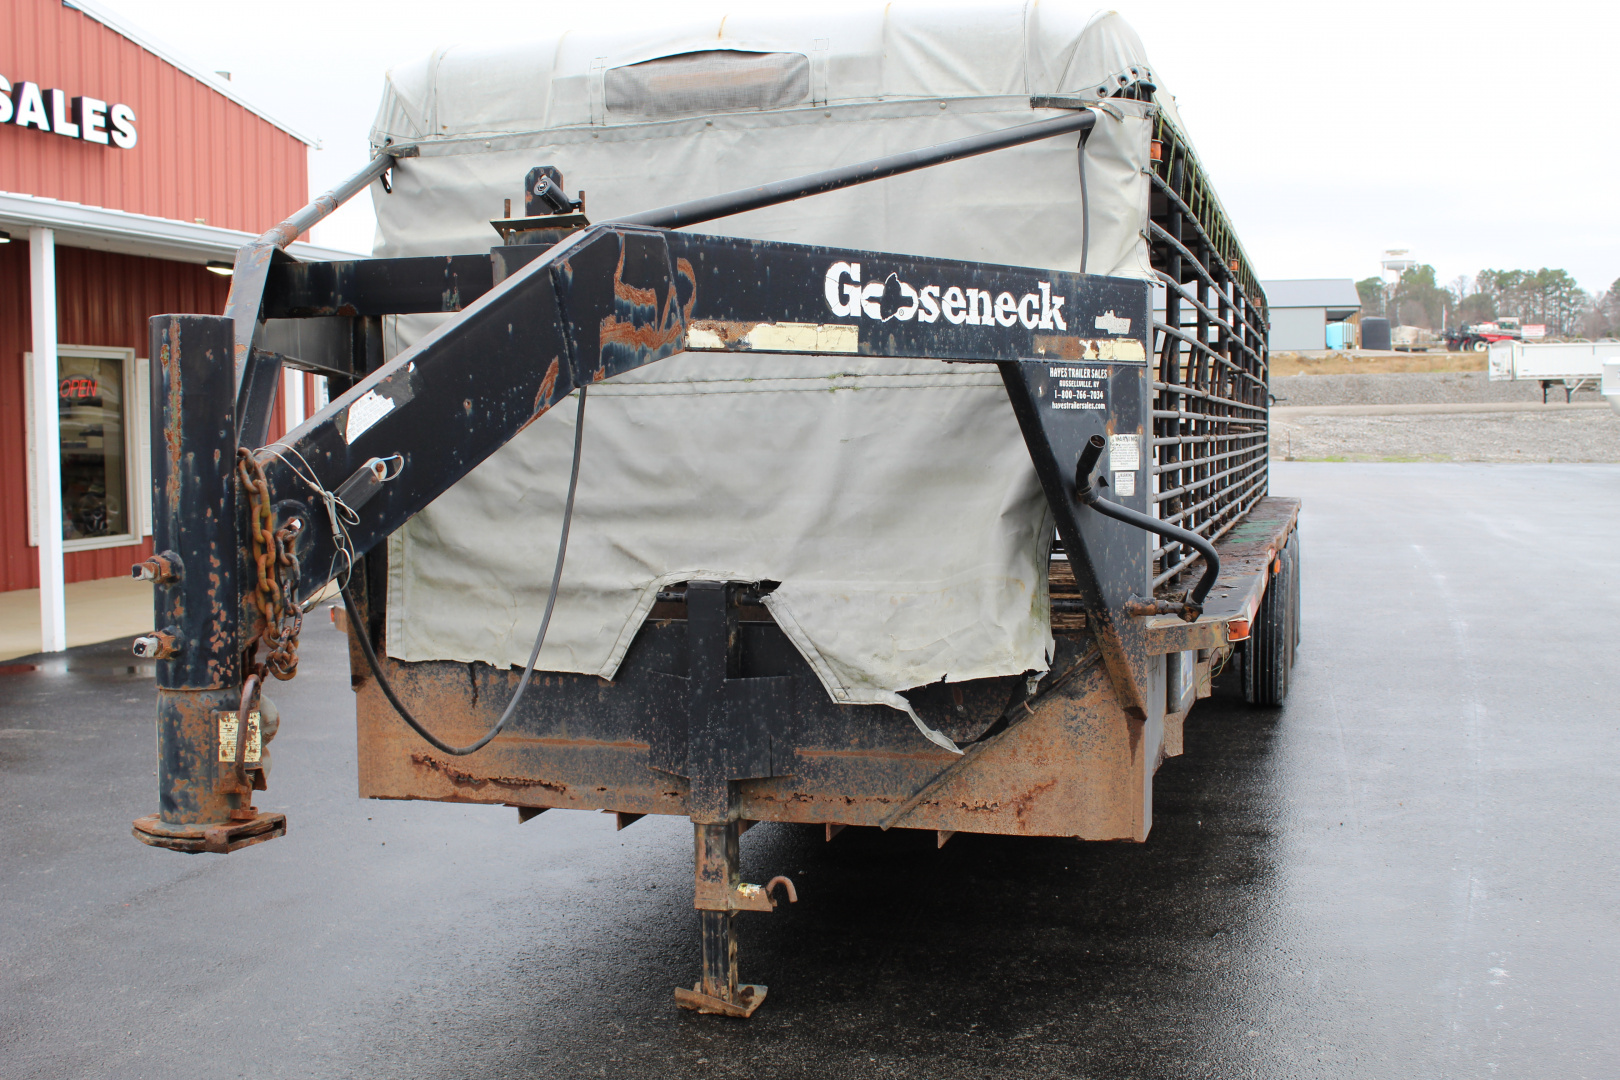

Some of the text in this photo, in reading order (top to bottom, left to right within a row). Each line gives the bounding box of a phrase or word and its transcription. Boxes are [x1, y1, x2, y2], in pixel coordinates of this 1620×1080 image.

[1049, 367, 1108, 380] HAYES TRAILER SALES
[60, 379, 98, 398] OPEN
[1093, 380, 1100, 388] KY
[1051, 401, 1106, 410] hayestrailersales.com
